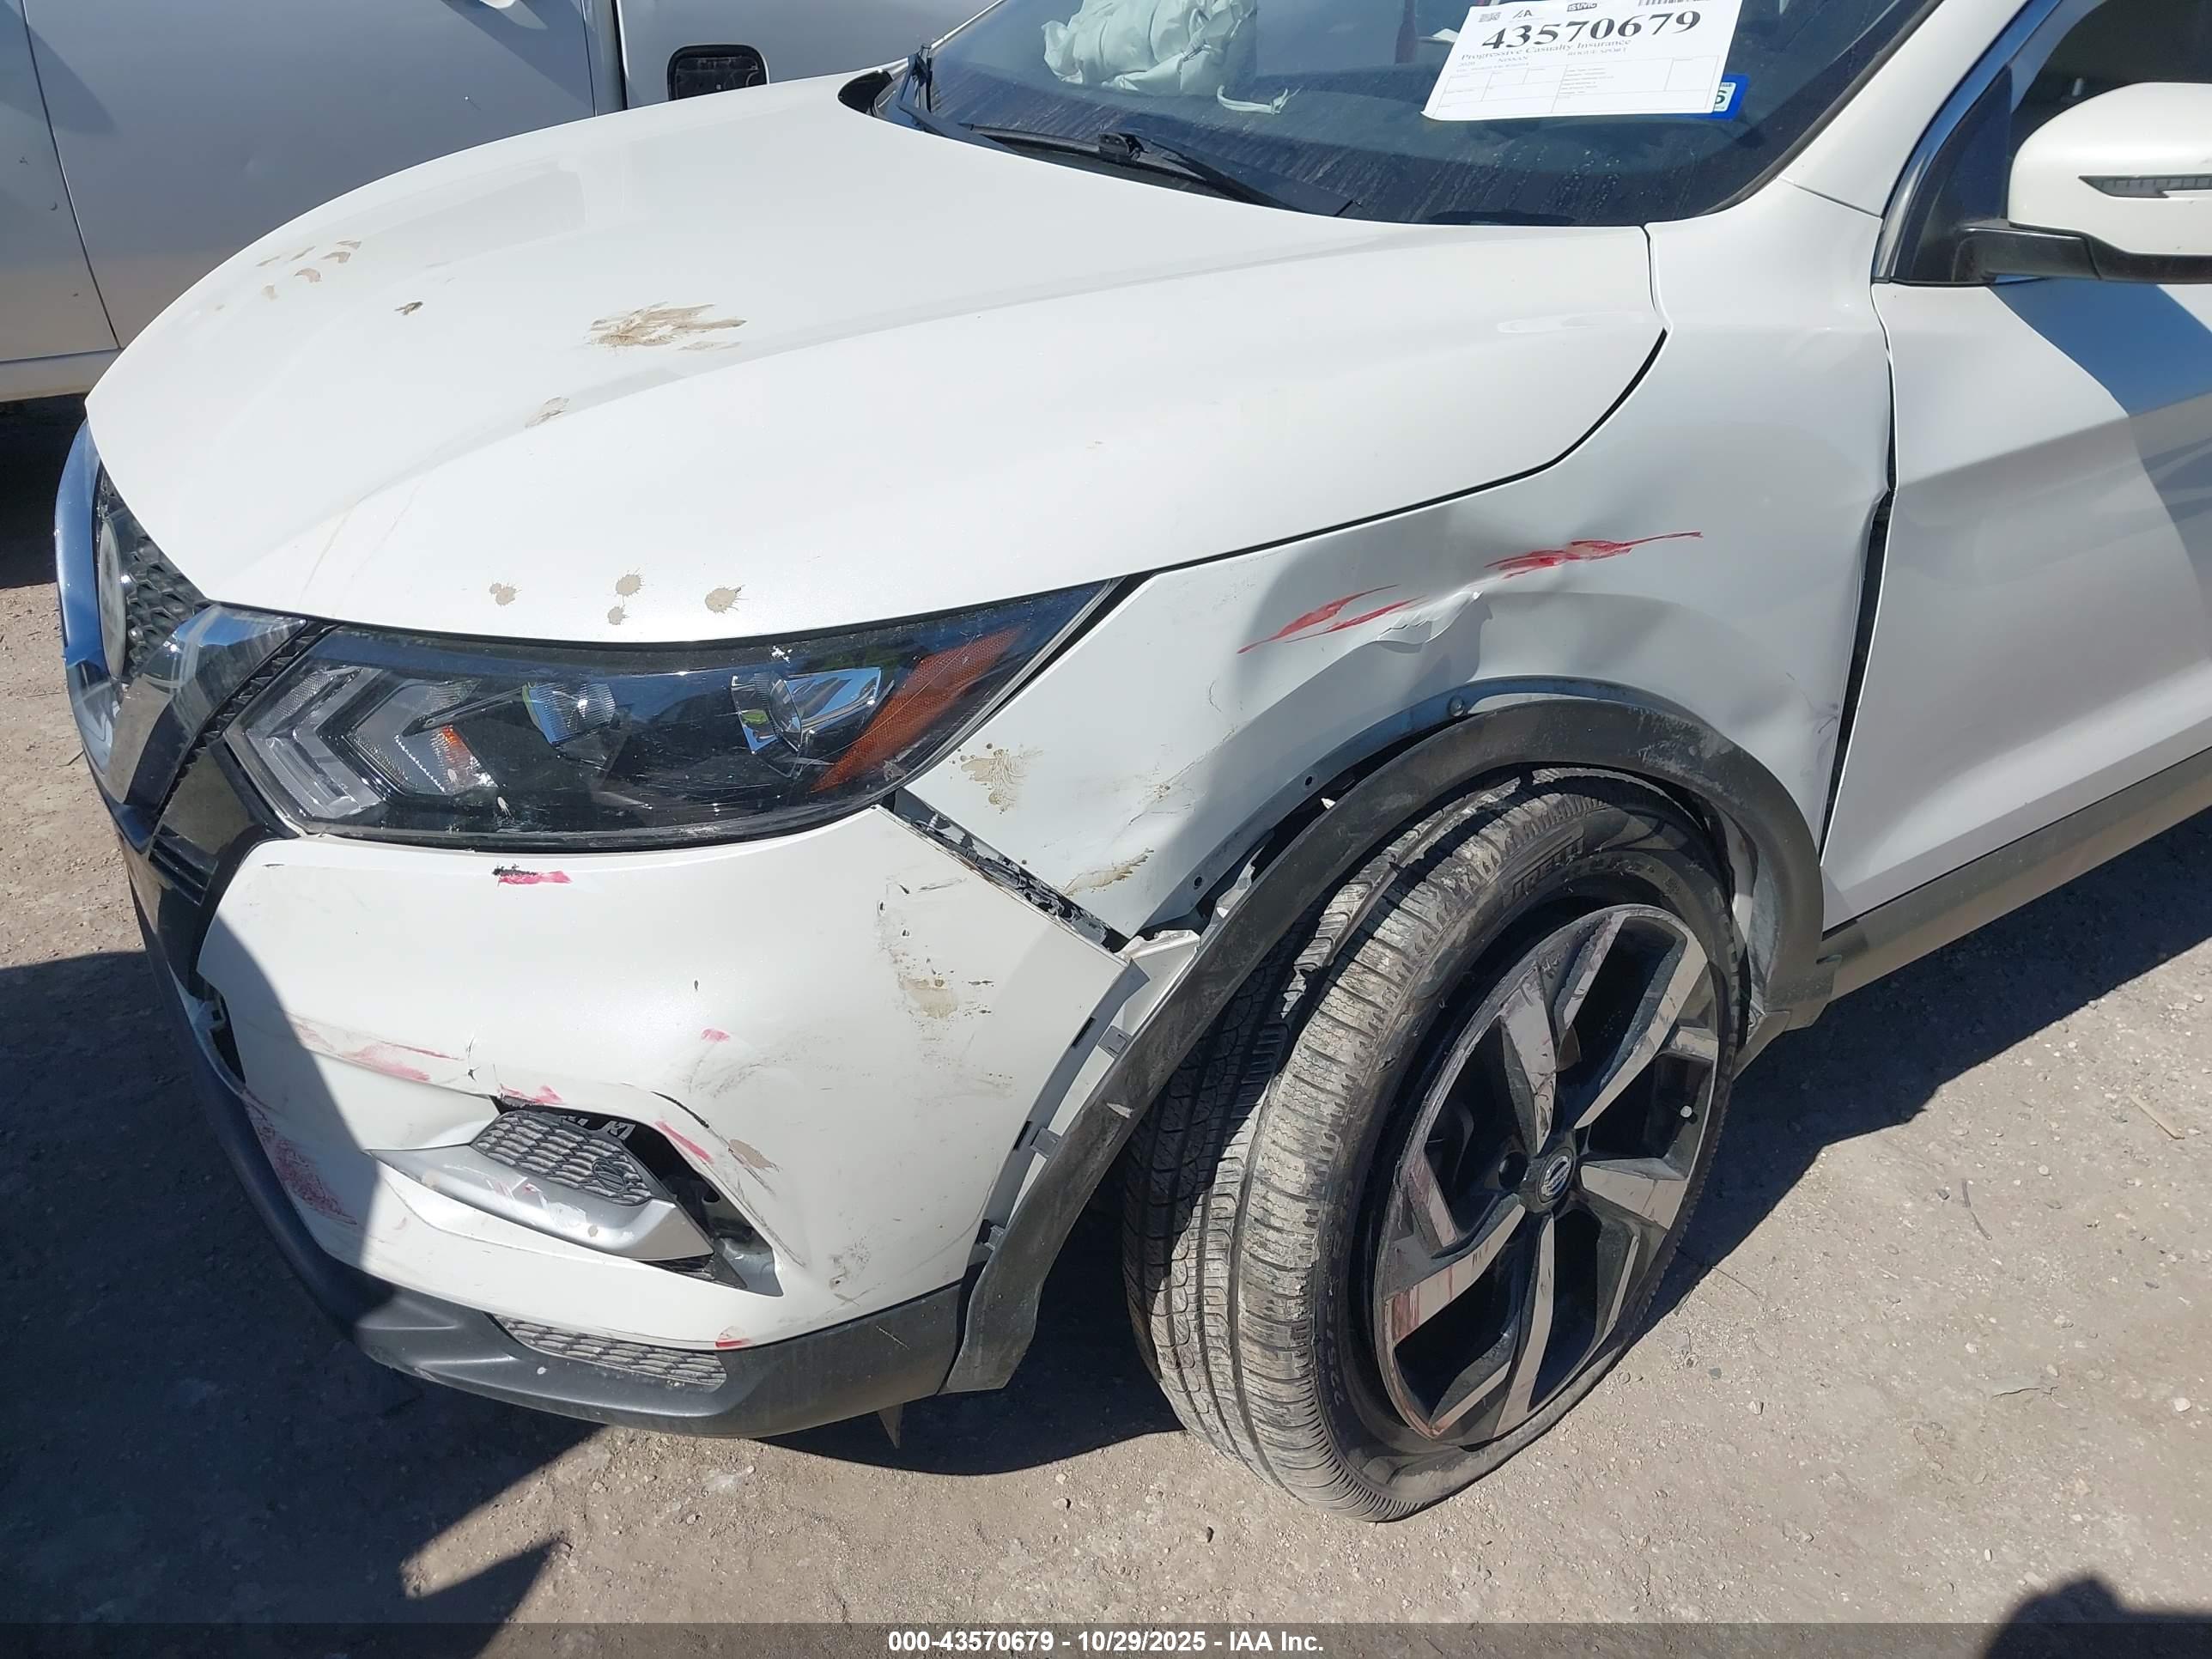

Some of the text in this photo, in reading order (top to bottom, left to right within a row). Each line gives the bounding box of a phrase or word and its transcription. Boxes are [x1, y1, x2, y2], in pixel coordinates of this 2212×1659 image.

[1481, 10, 1702, 50] 43570679
[1462, 40, 1632, 61] Progressive Casualty Insurance
